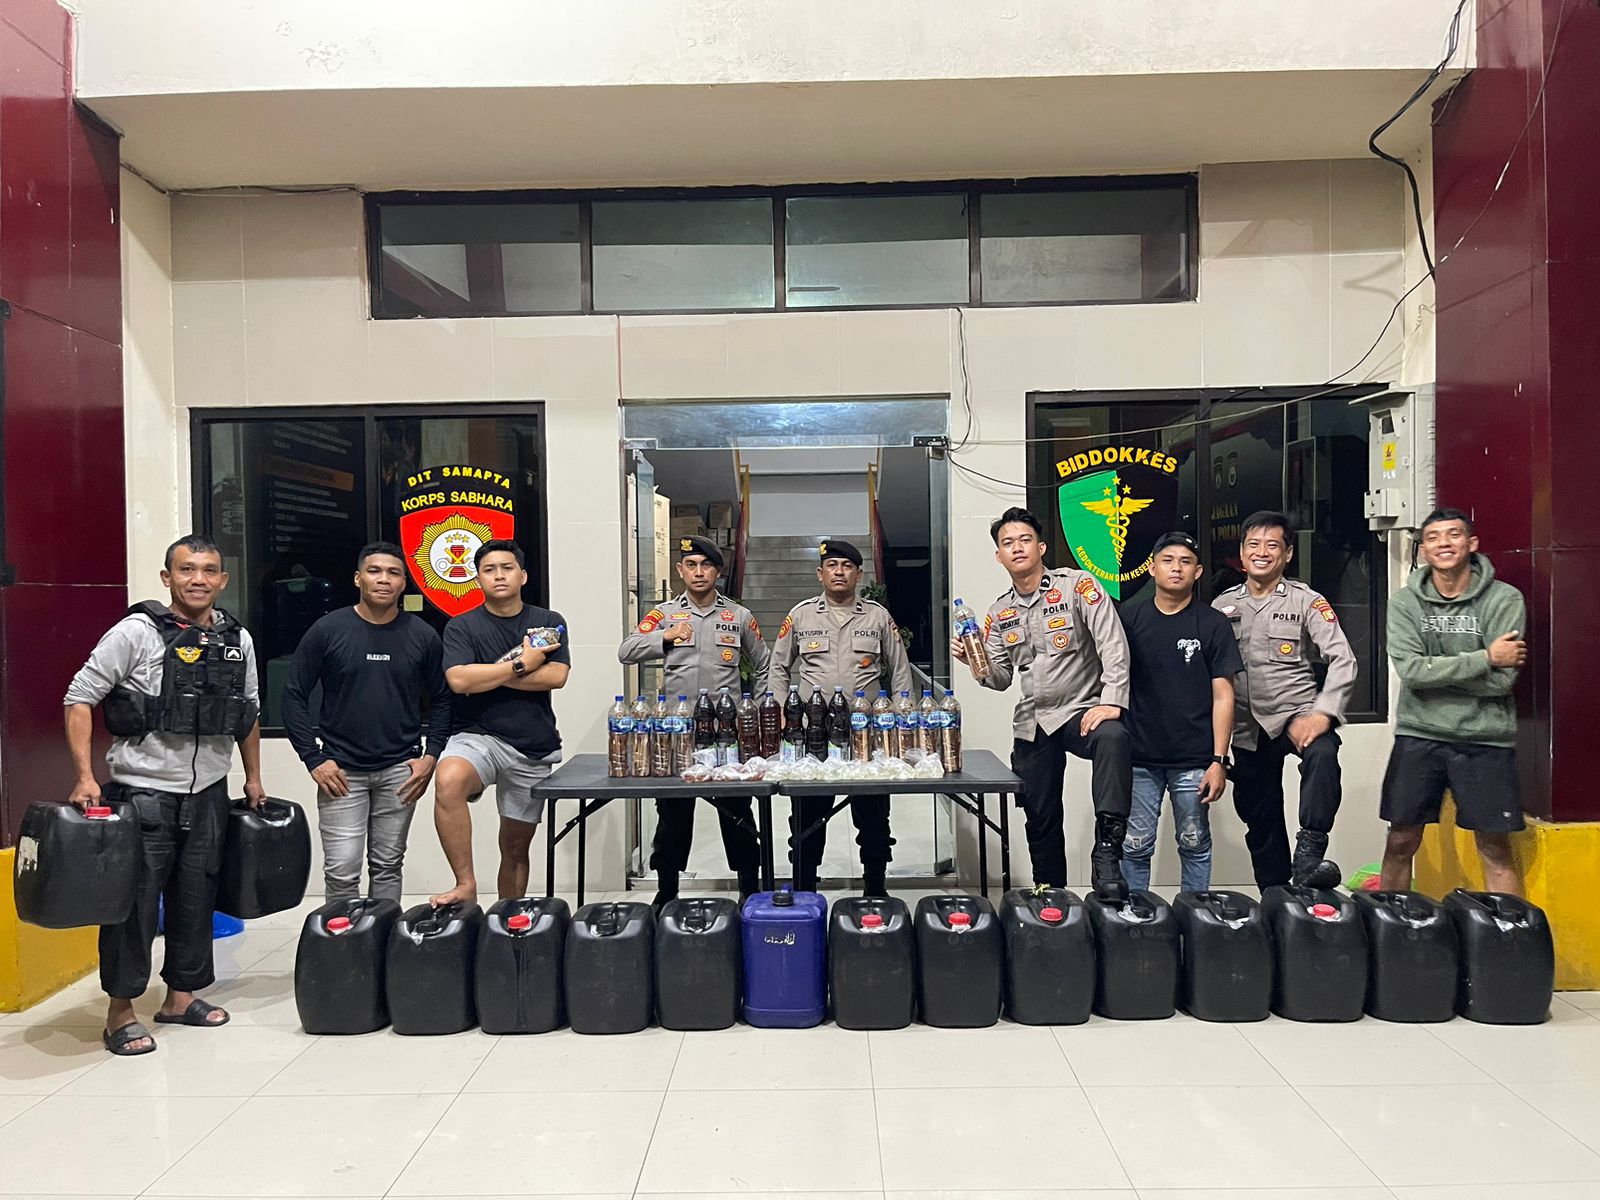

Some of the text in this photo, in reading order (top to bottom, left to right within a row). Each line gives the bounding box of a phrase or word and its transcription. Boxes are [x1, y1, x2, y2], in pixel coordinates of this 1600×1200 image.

[1056, 446, 1178, 478] BIDDOKKES
[407, 466, 510, 489] DIT SAMAPTA
[401, 491, 513, 512] KORPS SABHARA
[1075, 545, 1114, 581] KEDOKTERAN
[1115, 572, 1130, 582] DAN
[1043, 603, 1068, 615] POLRI
[1272, 612, 1300, 622] POLRI
[715, 623, 740, 633] POLRI
[854, 630, 879, 638] POLRI
